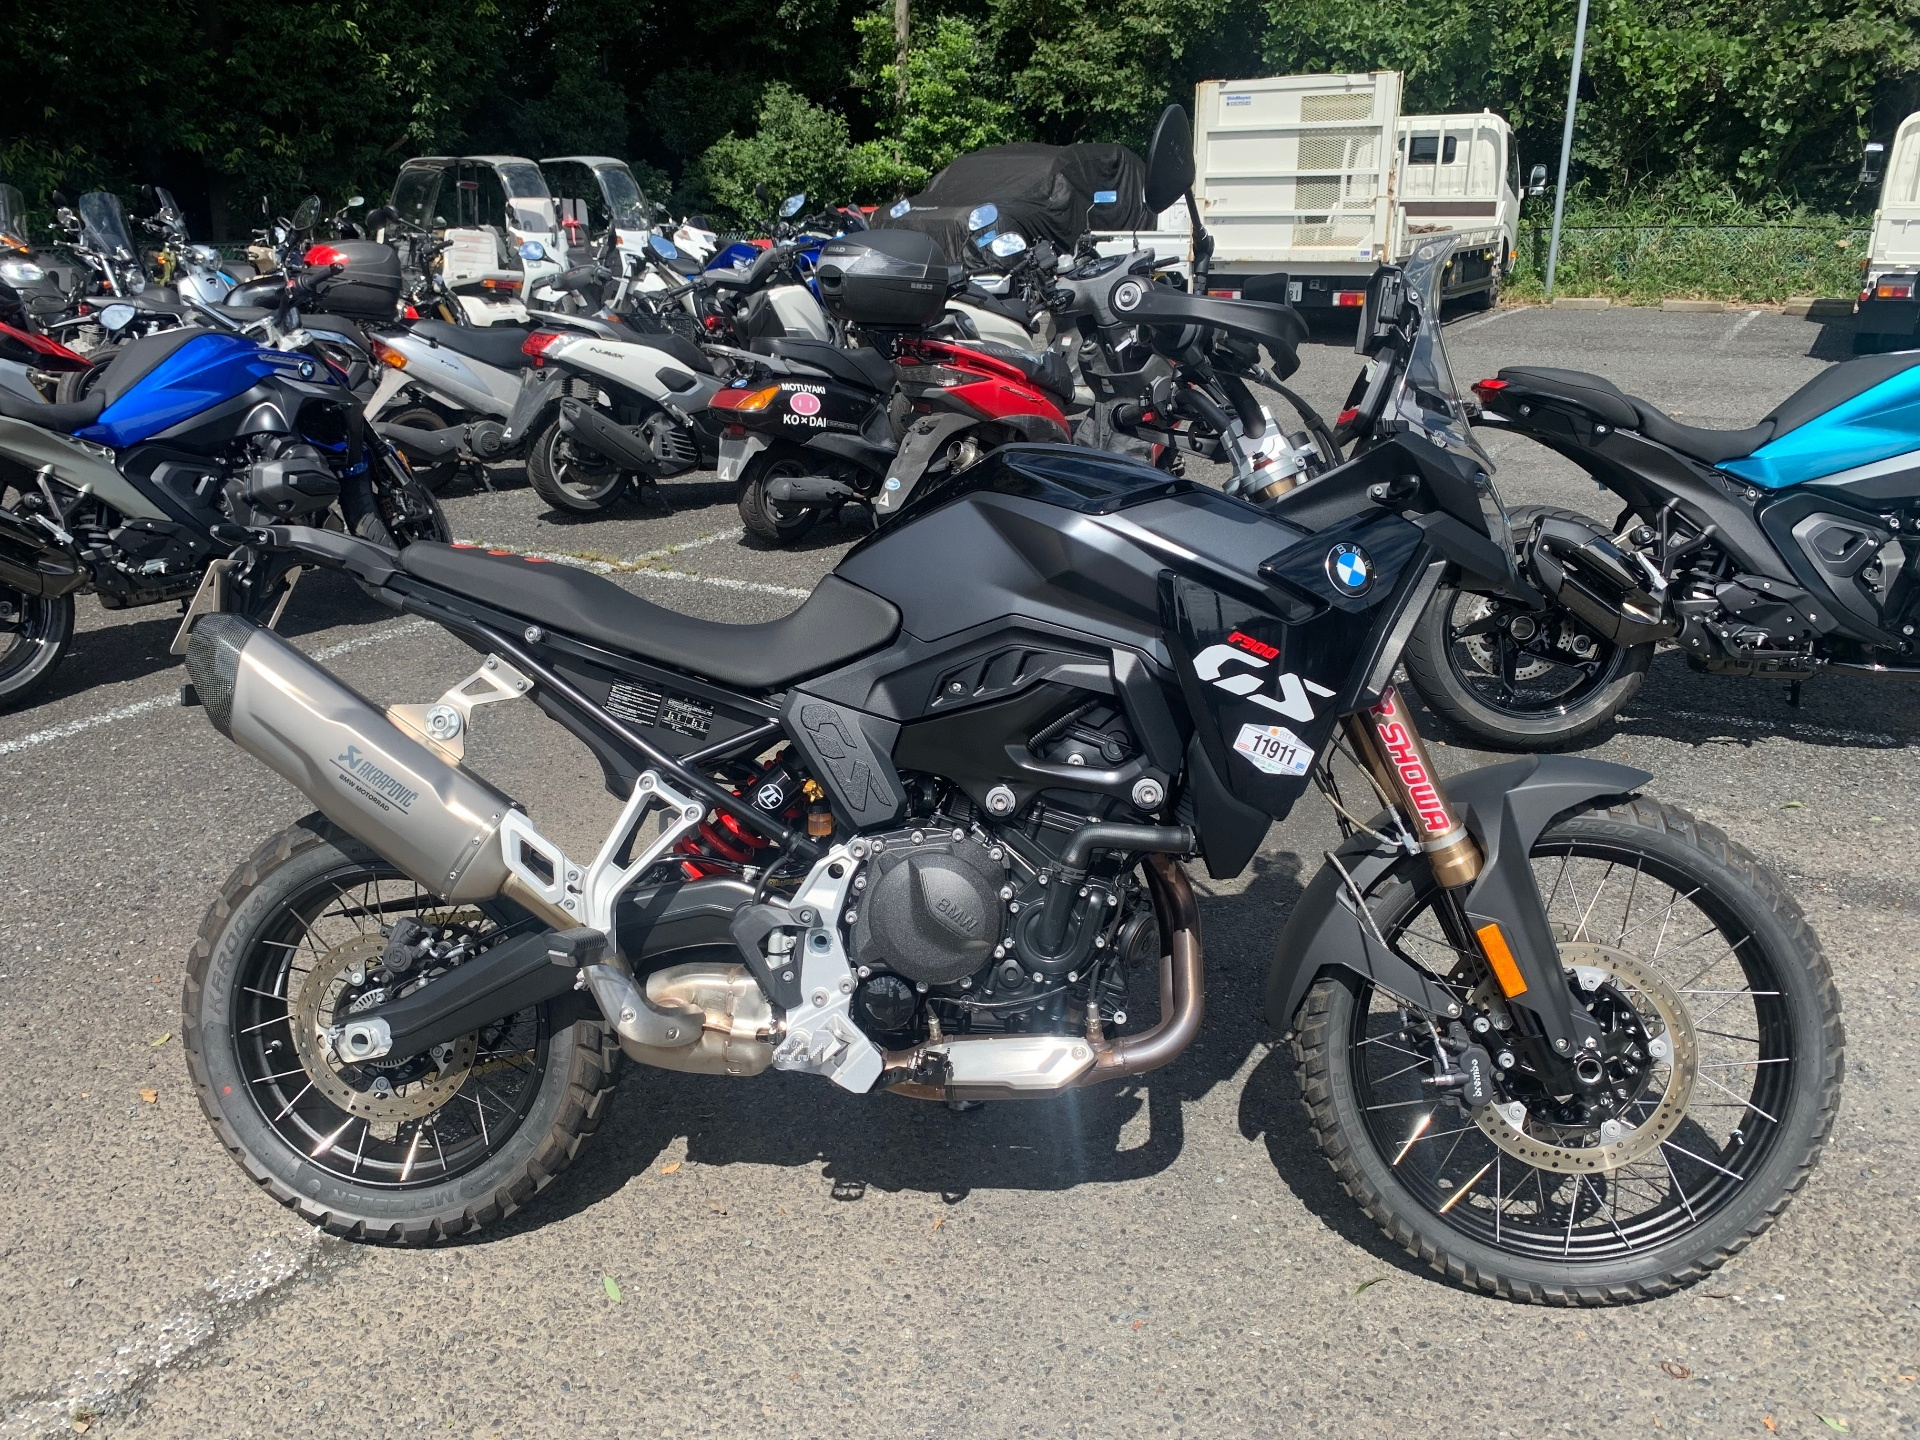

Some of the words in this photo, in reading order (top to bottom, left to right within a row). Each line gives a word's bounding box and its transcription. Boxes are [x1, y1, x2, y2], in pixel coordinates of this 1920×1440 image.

[781, 382, 826, 394] MOTUYAKI
[1227, 630, 1280, 660] F900
[1252, 734, 1297, 766] 11911
[338, 773, 356, 788] BMW
[354, 784, 391, 812] MOTORRAD
[1377, 721, 1451, 832] SHOWA
[758, 784, 783, 810] ZF
[1550, 819, 1639, 841] AROO
[936, 898, 979, 932] BMW
[207, 912, 251, 1015] KAROO
[1471, 1058, 1483, 1097] brembo
[1332, 1072, 1387, 1182] METZELER
